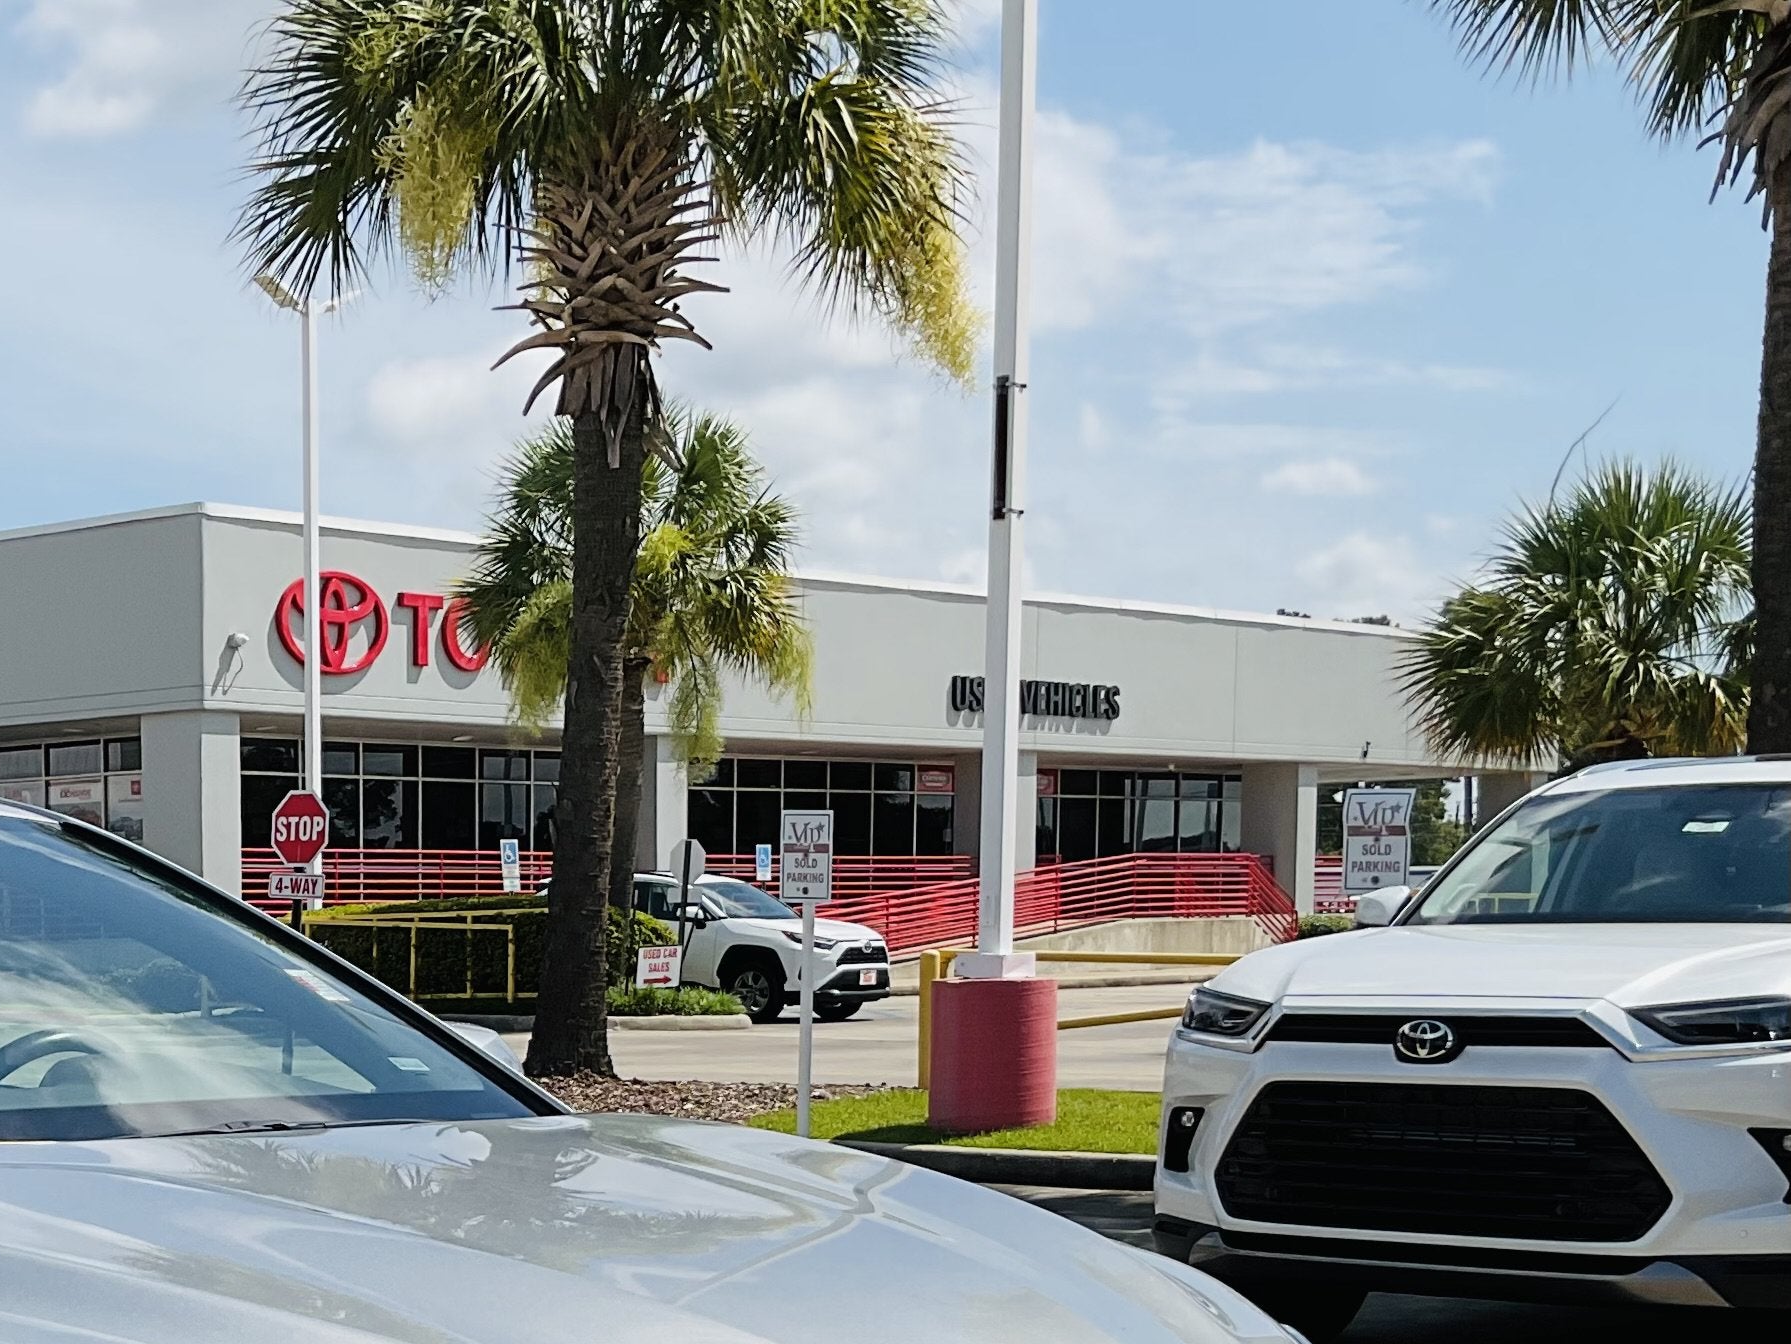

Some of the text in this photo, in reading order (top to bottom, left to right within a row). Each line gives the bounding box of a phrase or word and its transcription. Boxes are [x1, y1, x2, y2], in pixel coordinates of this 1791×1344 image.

[951, 675, 1120, 720] US VEHICLES
[276, 815, 324, 841] STOP
[1361, 844, 1392, 856] SOLD
[794, 858, 818, 868] SOLD
[1351, 861, 1401, 873] PARKING
[786, 872, 824, 883] PARKING
[275, 877, 318, 895] 4-WAY
[643, 948, 677, 959] USED CAR
[648, 962, 670, 973] SALES
